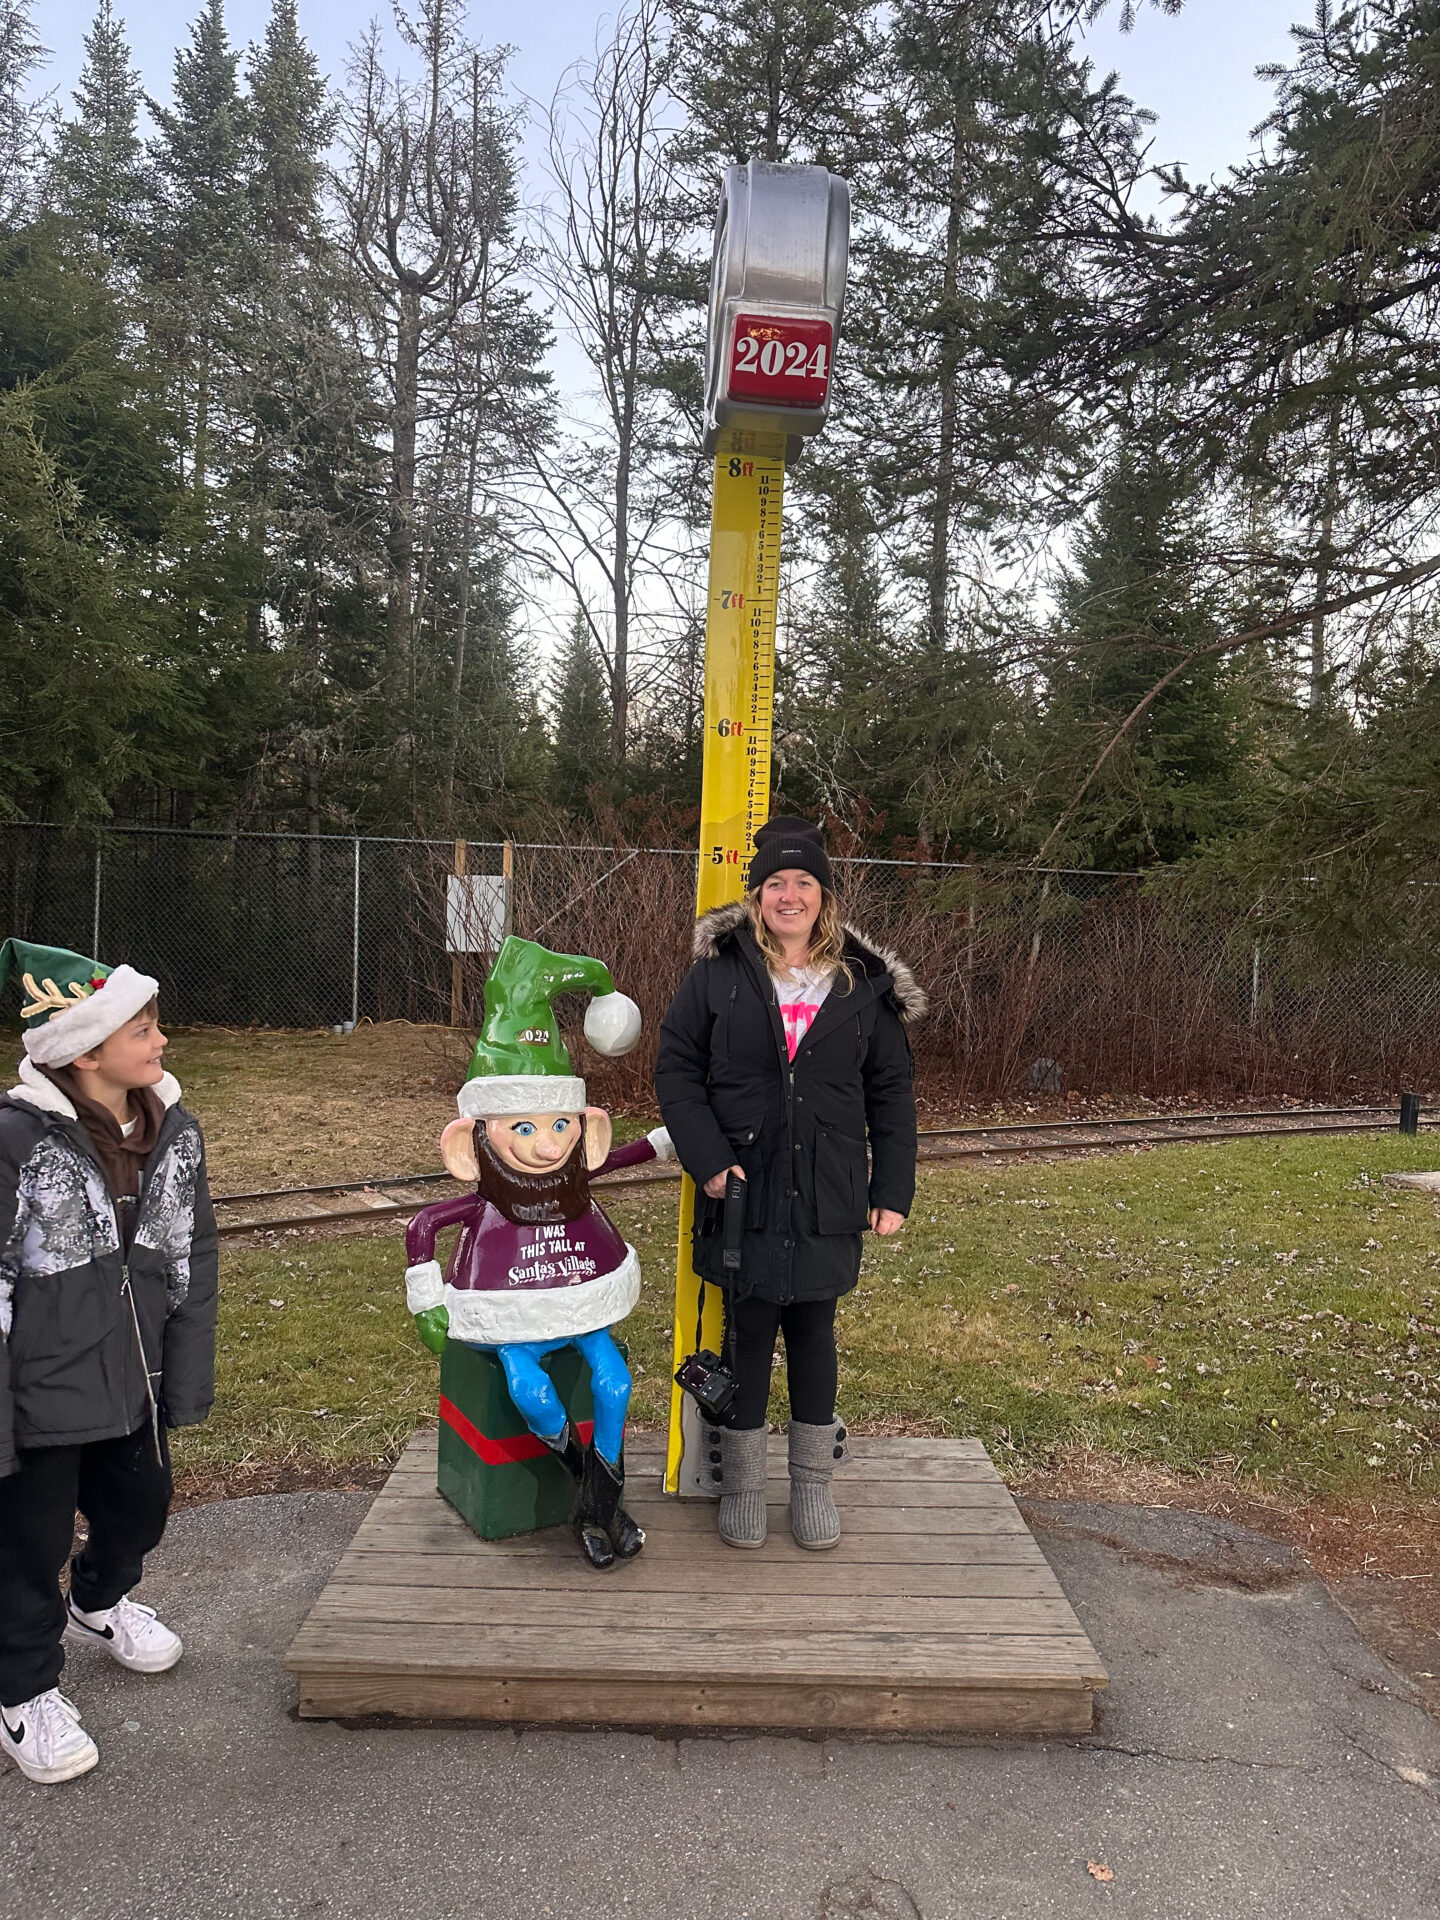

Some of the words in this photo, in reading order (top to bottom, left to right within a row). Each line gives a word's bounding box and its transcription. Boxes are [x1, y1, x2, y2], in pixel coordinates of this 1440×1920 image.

[735, 337, 828, 379] 2024
[761, 475, 769, 484] 11
[758, 486, 770, 496] 10
[760, 497, 767, 507] 9
[760, 508, 767, 517] 8
[760, 520, 766, 529] 7
[758, 530, 765, 540] 6
[758, 541, 764, 550] 5
[757, 552, 763, 562] 4
[757, 563, 763, 573] 3
[756, 574, 763, 583] 2
[757, 585, 762, 595] 1
[753, 608, 761, 617] 11
[750, 618, 761, 628] 10
[753, 629, 760, 639] 9
[753, 640, 759, 649] 8
[753, 651, 759, 661] 7
[753, 662, 759, 671] 6
[753, 673, 759, 682] 5
[752, 683, 758, 692] 4
[751, 693, 758, 703] 3
[751, 704, 757, 713] 2
[752, 715, 756, 724] 1
[748, 735, 757, 744] 11
[746, 747, 757, 756] 10
[750, 757, 757, 767] 9
[749, 768, 756, 778] 8
[749, 778, 756, 788] 7
[747, 789, 754, 798] 6
[747, 800, 753, 809] 5
[746, 810, 753, 820] 4
[745, 821, 752, 831] 3
[745, 832, 752, 841] 2
[746, 842, 751, 852] 1
[535, 1227, 540, 1241] I
[543, 1225, 566, 1239] WAS
[520, 1242, 546, 1260] THIS
[549, 1239, 573, 1254] TALL
[574, 1241, 586, 1252] AT
[508, 1260, 556, 1287] Santa's
[555, 1255, 597, 1277] Village
